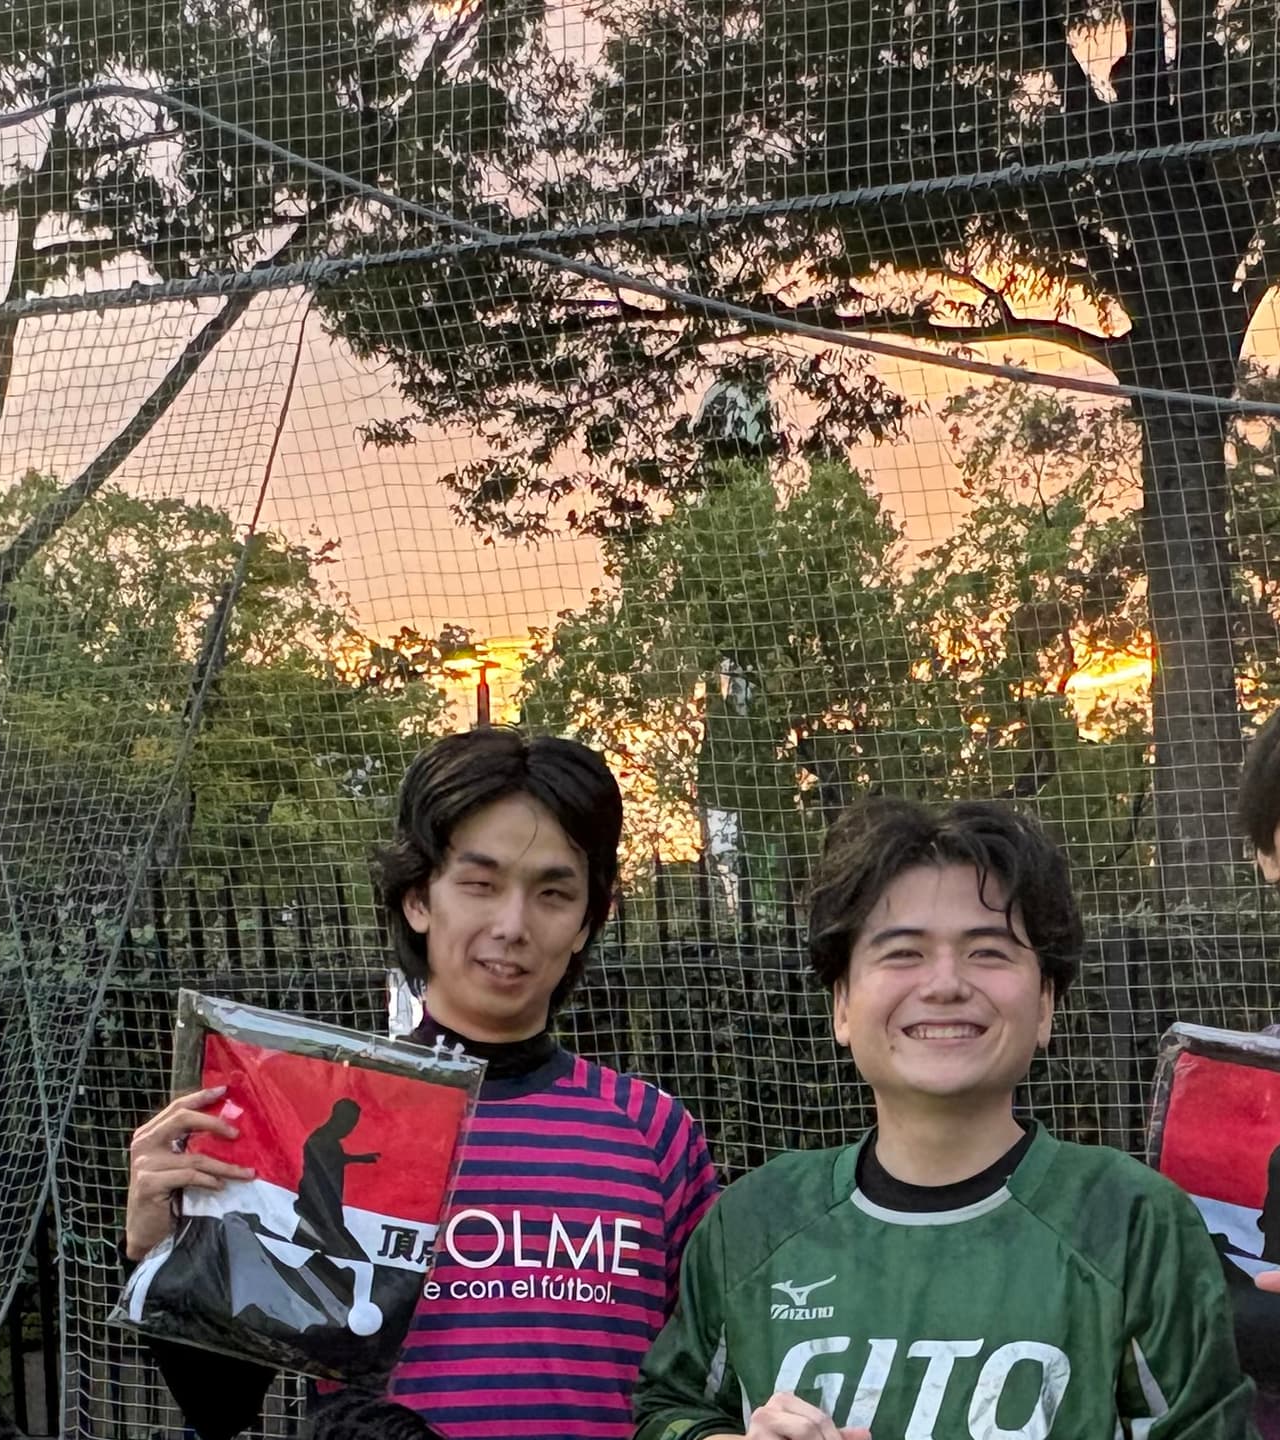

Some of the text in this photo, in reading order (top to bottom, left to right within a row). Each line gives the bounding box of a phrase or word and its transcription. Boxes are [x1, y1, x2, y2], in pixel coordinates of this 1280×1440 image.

[445, 1208, 642, 1277] OLME
[450, 1279, 505, 1300] con
[511, 1274, 535, 1299] el
